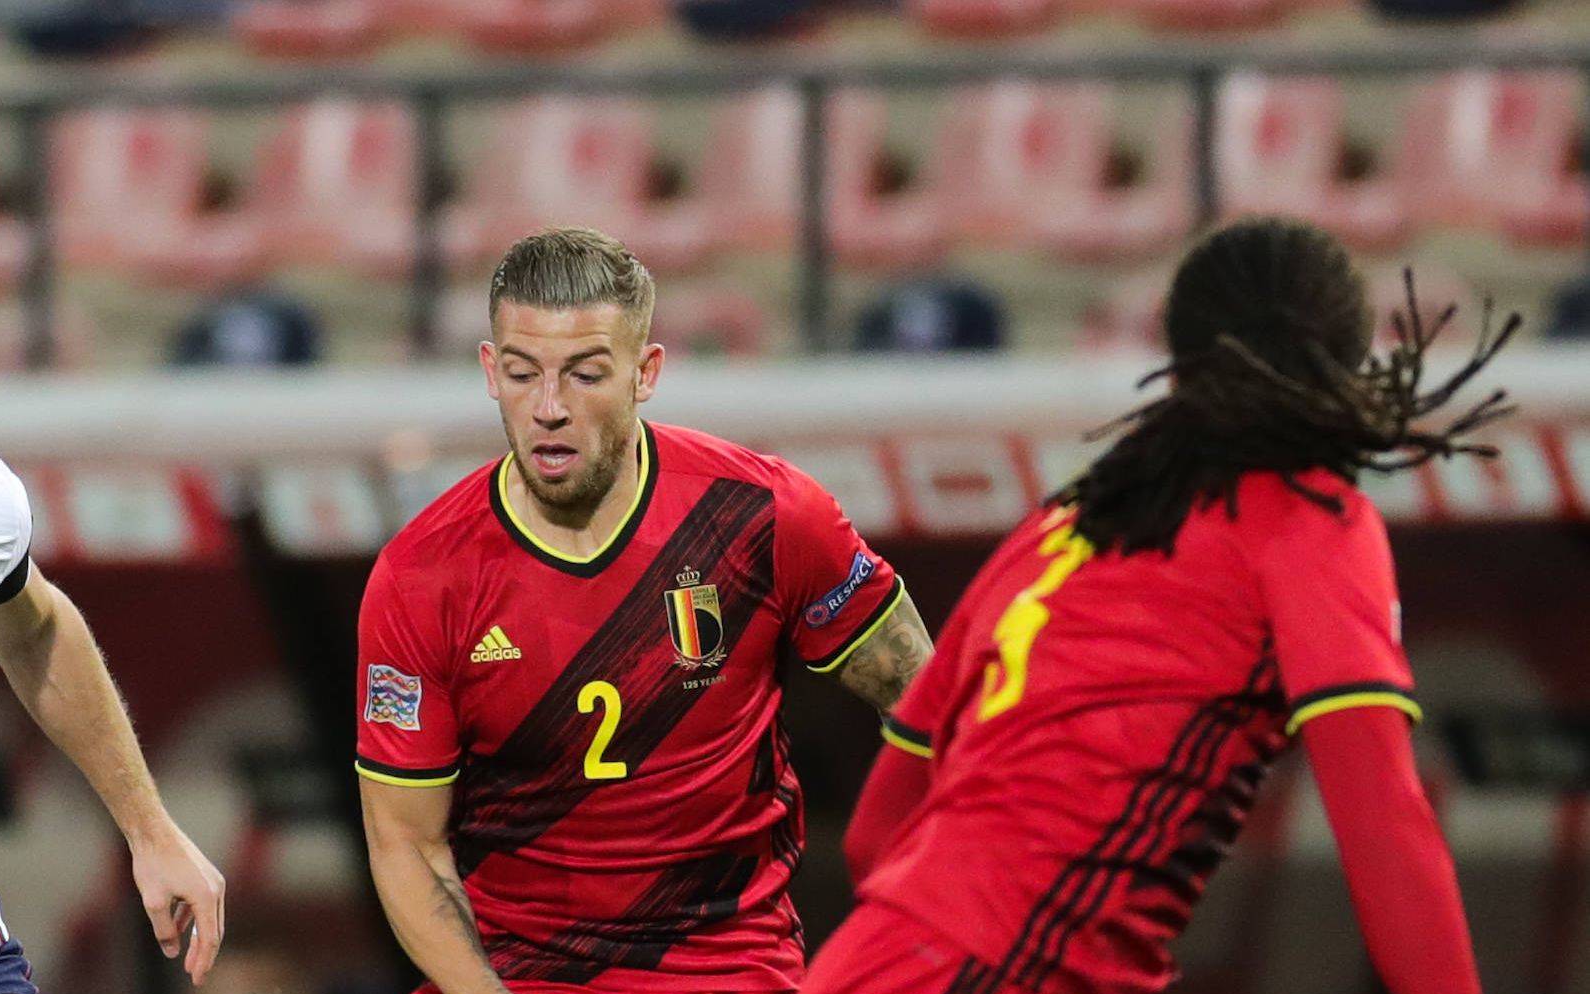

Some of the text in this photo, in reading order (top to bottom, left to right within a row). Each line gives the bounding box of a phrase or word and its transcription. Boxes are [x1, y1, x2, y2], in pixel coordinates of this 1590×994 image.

[828, 555, 871, 610] RESPECT
[470, 647, 522, 663] adidas
[577, 680, 627, 780] 2
